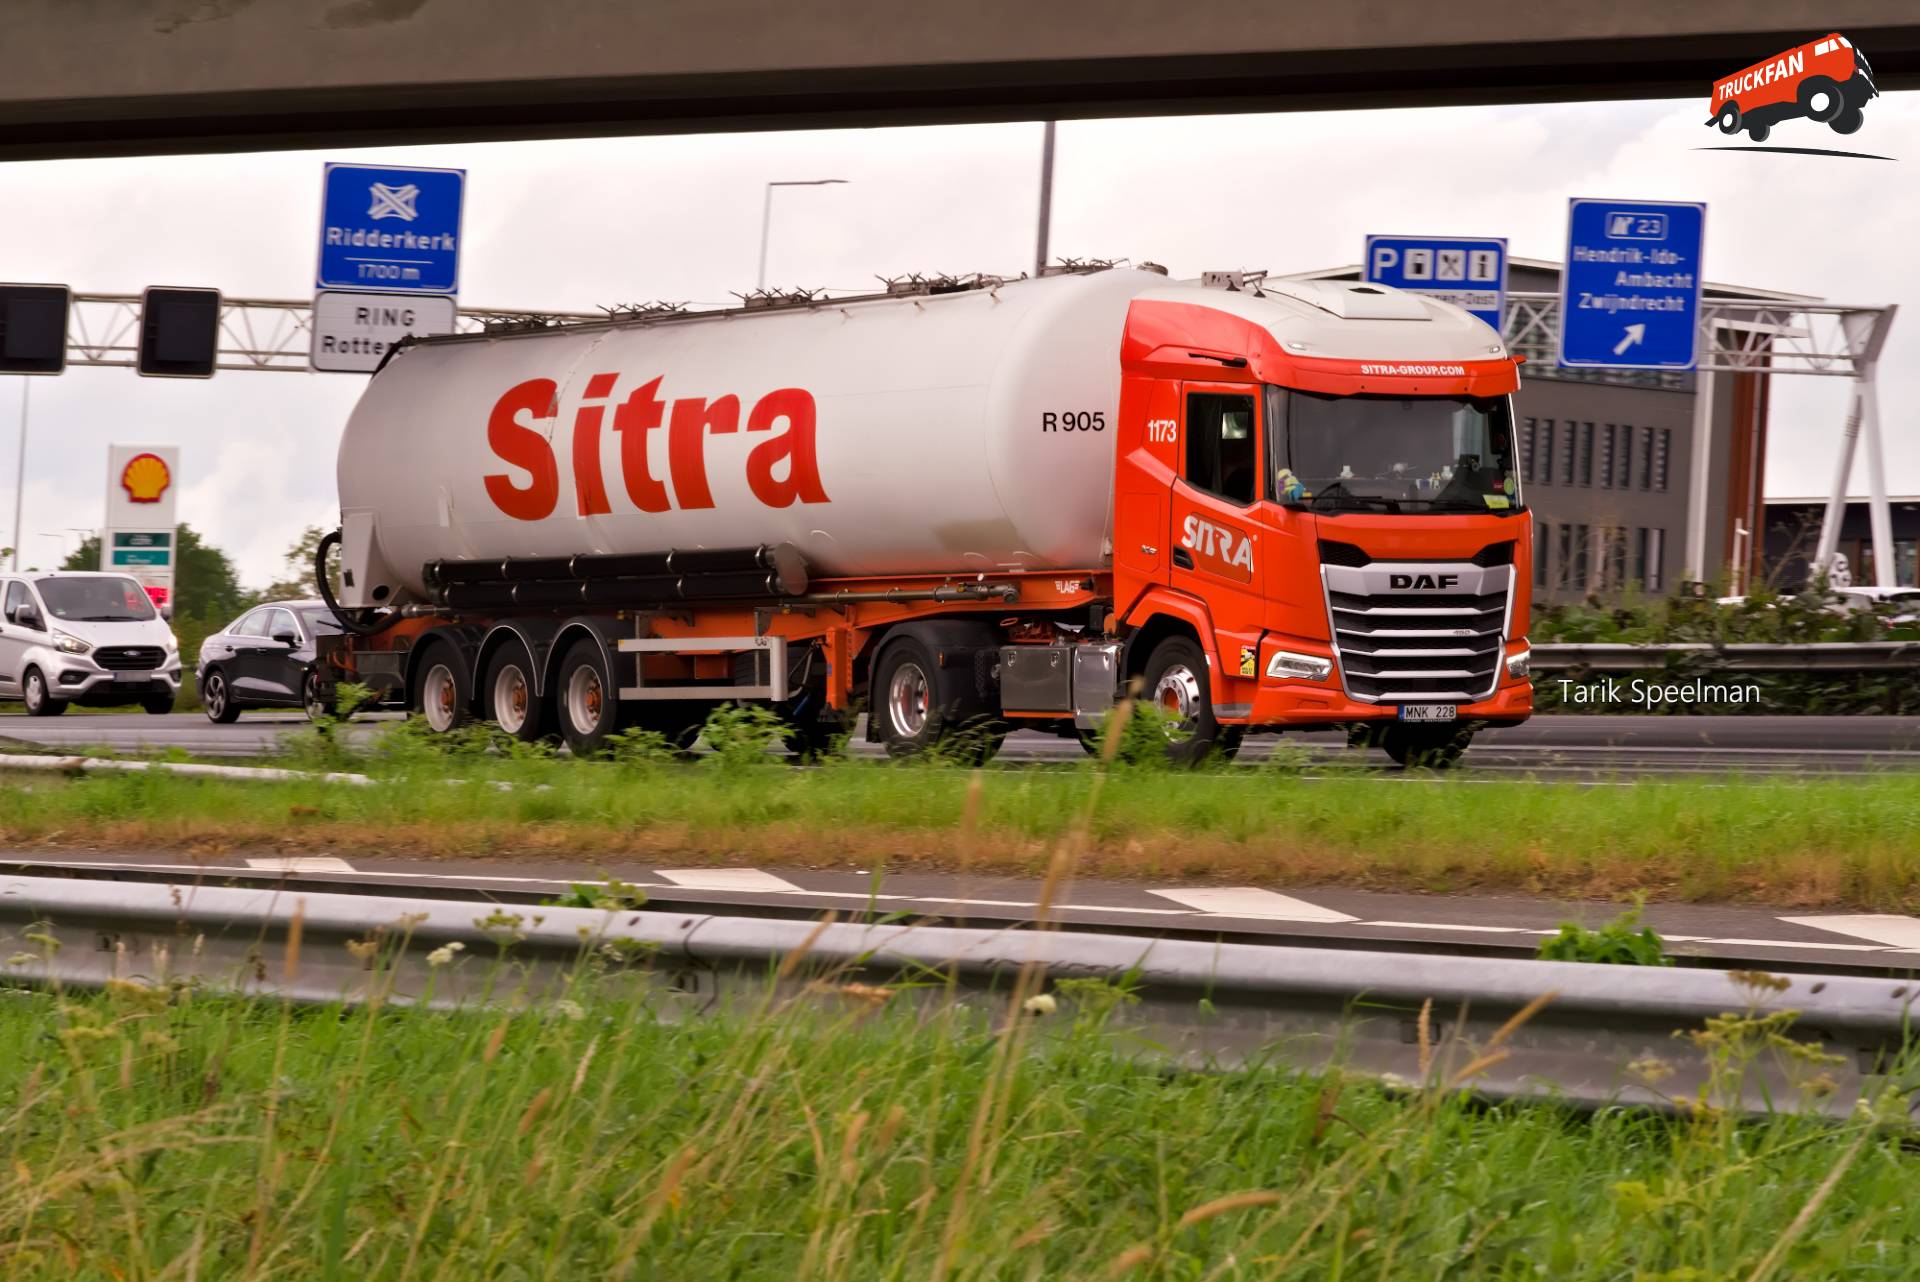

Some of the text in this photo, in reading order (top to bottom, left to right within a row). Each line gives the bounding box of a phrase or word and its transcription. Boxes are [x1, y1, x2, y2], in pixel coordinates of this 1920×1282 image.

[1637, 219, 1661, 234] 23
[326, 227, 455, 250] Ridderkerk
[1373, 247, 1399, 279] P
[1573, 246, 1685, 264] Hendrik-Ido-
[1614, 271, 1693, 288] Ambacht
[1578, 293, 1685, 314] Zwijndrecht
[355, 307, 416, 327] RING
[1361, 364, 1465, 375] SITRA-GROUP.COM
[1042, 411, 1106, 432] R 905
[1148, 420, 1177, 442] 1173
[1181, 514, 1255, 573] SITRA
[1390, 574, 1458, 589] DAF
[1405, 706, 1455, 718] MNK 228
